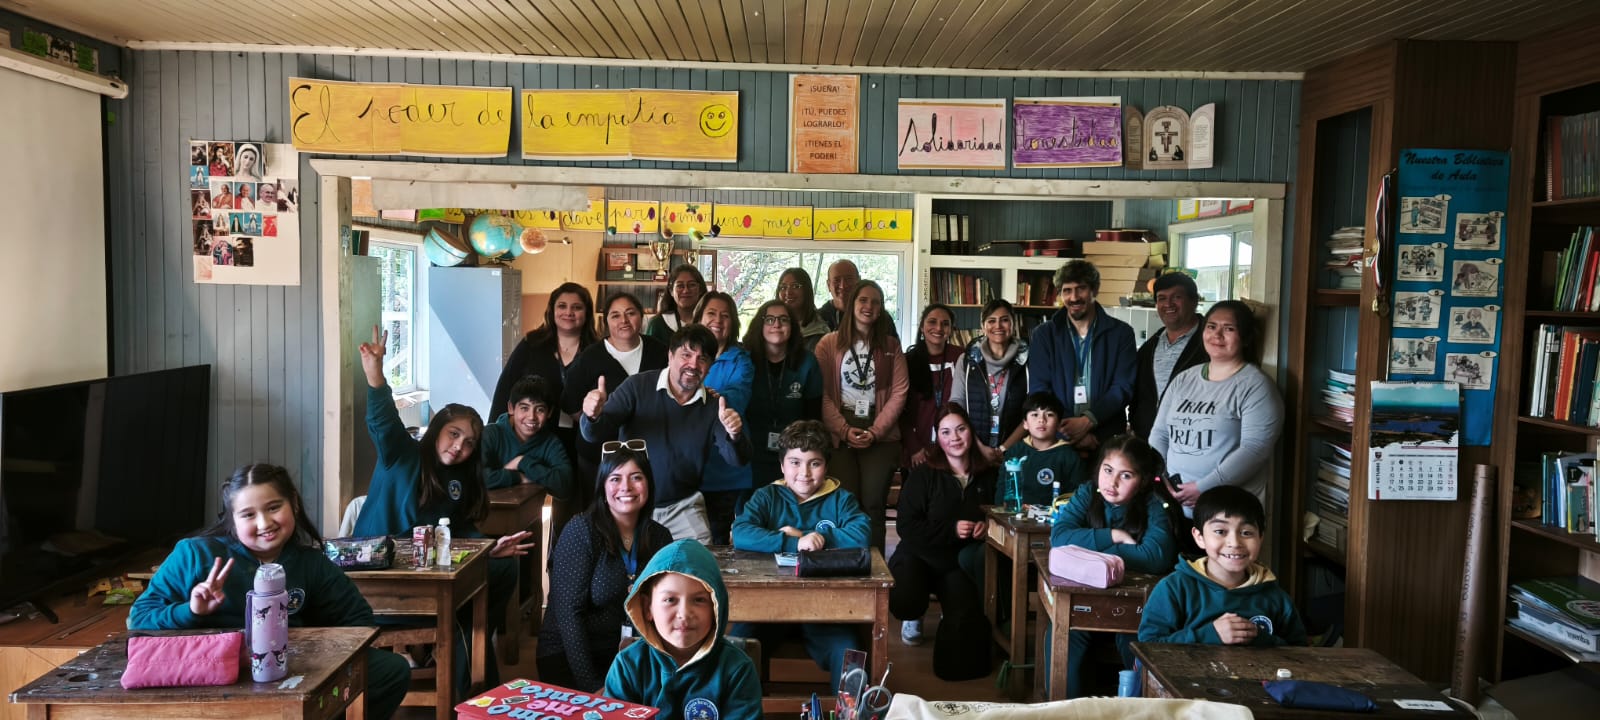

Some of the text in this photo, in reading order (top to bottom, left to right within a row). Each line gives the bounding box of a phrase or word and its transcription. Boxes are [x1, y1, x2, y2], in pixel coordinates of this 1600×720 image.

[810, 85, 840, 94] ¡SUEÑA!
[292, 84, 505, 147] El poder de
[527, 94, 555, 130] la
[818, 108, 847, 116] PUEDES
[803, 120, 845, 128] LOGRARLO!
[1013, 111, 1119, 153] Honestidad
[898, 112, 1003, 157] Solidaridad
[834, 140, 842, 148] EL
[809, 152, 837, 160] PODER!
[1404, 152, 1448, 165] Nuestra
[1430, 169, 1477, 181] de Aula
[815, 210, 899, 233] sociedad
[1176, 399, 1218, 415] TRICK
[1167, 424, 1217, 450] TREAT
[526, 699, 582, 716] me
